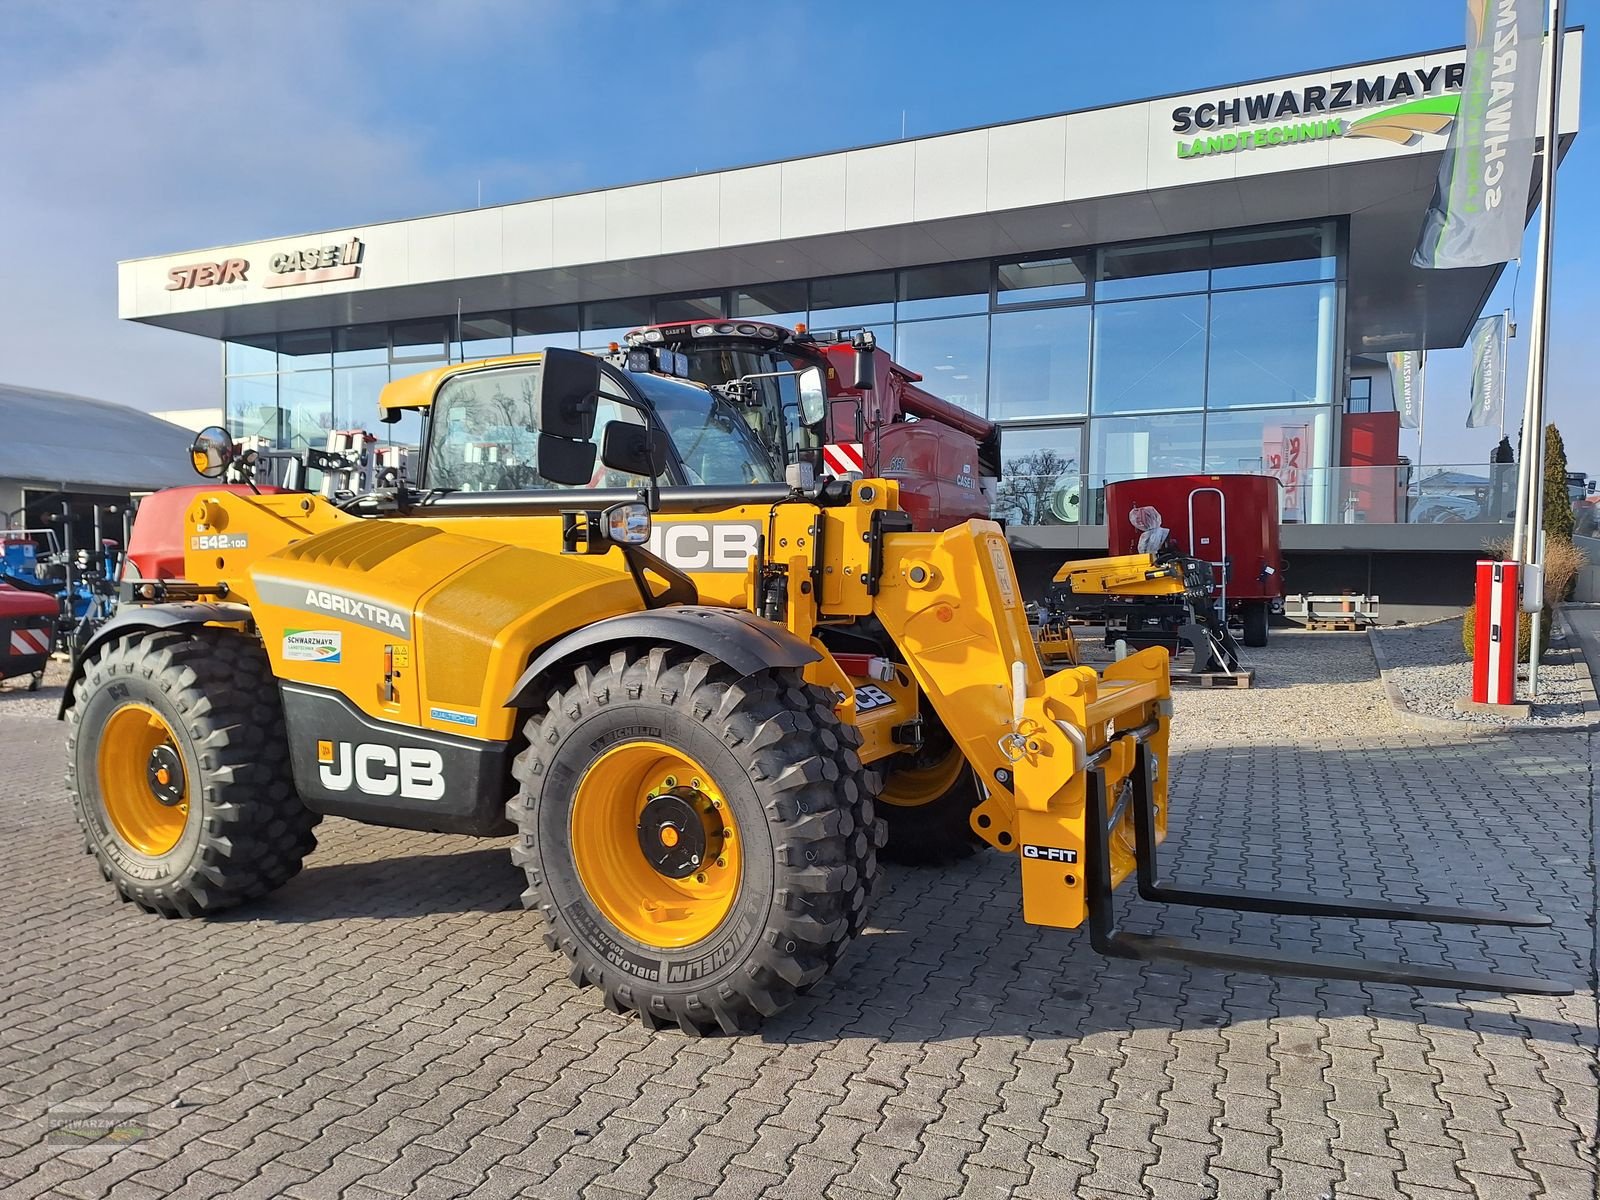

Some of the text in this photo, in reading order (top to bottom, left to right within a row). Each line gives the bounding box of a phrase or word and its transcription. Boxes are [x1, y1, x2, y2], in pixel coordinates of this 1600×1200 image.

[1172, 63, 1465, 132] SCHWARZMAYR
[1177, 118, 1343, 158] LANDTECHNIK
[165, 258, 250, 291] STEYR
[269, 246, 337, 273] CASE
[305, 589, 406, 632] AGRIXTRA
[287, 636, 333, 646] SCHWARZMAYR
[839, 685, 893, 711] CB
[319, 740, 445, 800] JCB
[1023, 845, 1076, 862] Q-FIT
[606, 951, 659, 981] BIBLOAD
[668, 916, 752, 983] MICHELIN
